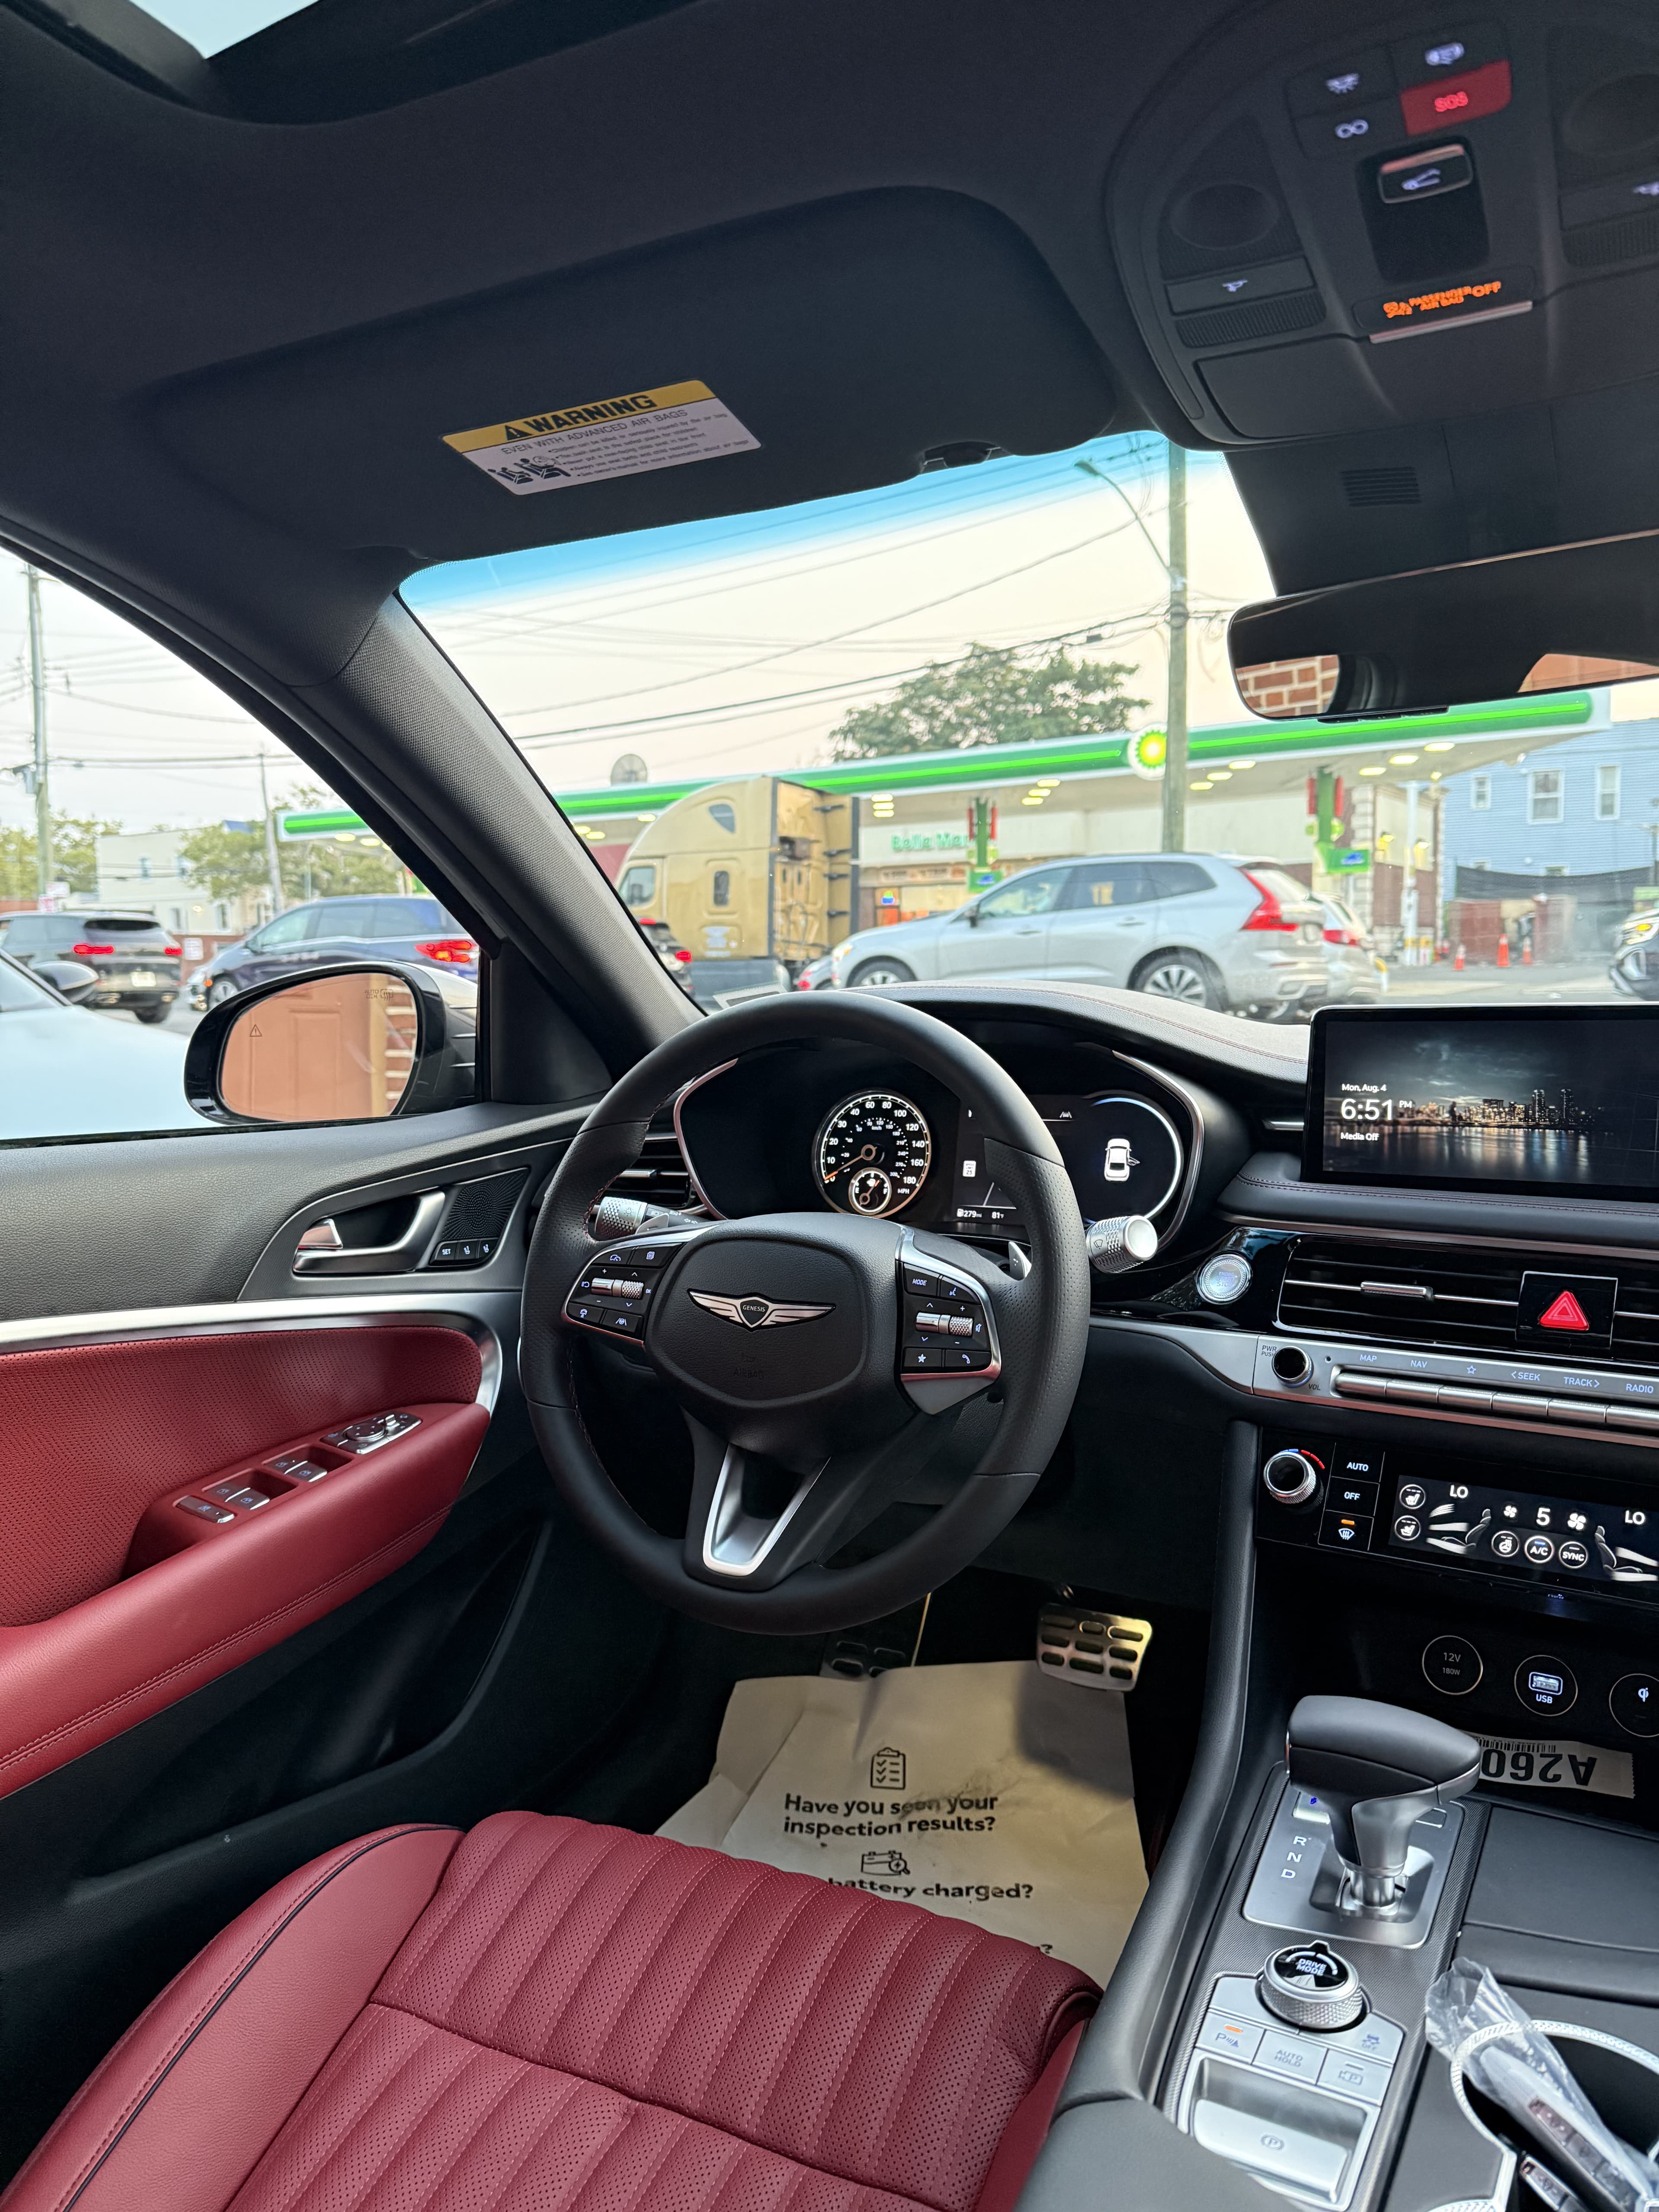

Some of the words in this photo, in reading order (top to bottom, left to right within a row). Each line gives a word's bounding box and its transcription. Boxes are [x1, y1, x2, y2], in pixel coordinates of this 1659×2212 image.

[1434, 92, 1468, 112] SOS
[523, 395, 657, 432] WARNING
[501, 443, 533, 454] EVEN
[534, 436, 564, 447] WITH
[568, 423, 628, 441] ADVANCED
[631, 418, 652, 427] AIR
[654, 410, 688, 422] BAGS
[1341, 1084, 1361, 1092] Mon,
[1362, 1084, 1379, 1093] Aug.
[1341, 1098, 1393, 1120] 6:51
[1341, 1132, 1364, 1140] Media
[1411, 1360, 1427, 1368] NAV
[1518, 1372, 1541, 1381] SEEK
[1564, 1377, 1592, 1387] TRACK
[1626, 1384, 1654, 1394] RADIO
[1346, 1462, 1369, 1471] AUTO
[1344, 1491, 1360, 1500] OFF
[1449, 1484, 1468, 1498] LO
[1536, 1507, 1550, 1526] 5
[1625, 1510, 1645, 1525] LO
[1530, 1545, 1548, 1556] A/C
[1562, 1551, 1584, 1562] SYNC
[1443, 1652, 1461, 1662] 12V
[1442, 1667, 1460, 1675] 180W
[1535, 1694, 1553, 1704] USB
[1481, 1748, 1597, 1786] A260
[785, 1793, 839, 1813] Have
[843, 1800, 884, 1817] you
[947, 1796, 998, 1815] your
[784, 1816, 902, 1838] inspection
[908, 1816, 996, 1832] results?
[1293, 1836, 1307, 1846] R
[1287, 1852, 1302, 1862] N
[1281, 1868, 1296, 1878] D
[922, 1883, 1033, 1901] charged?
[1298, 1958, 1327, 1969] DRIVE
[1296, 1964, 1325, 1976] MODE
[1276, 2049, 1303, 2062] AUTO
[1274, 2055, 1301, 2068] HOLD
